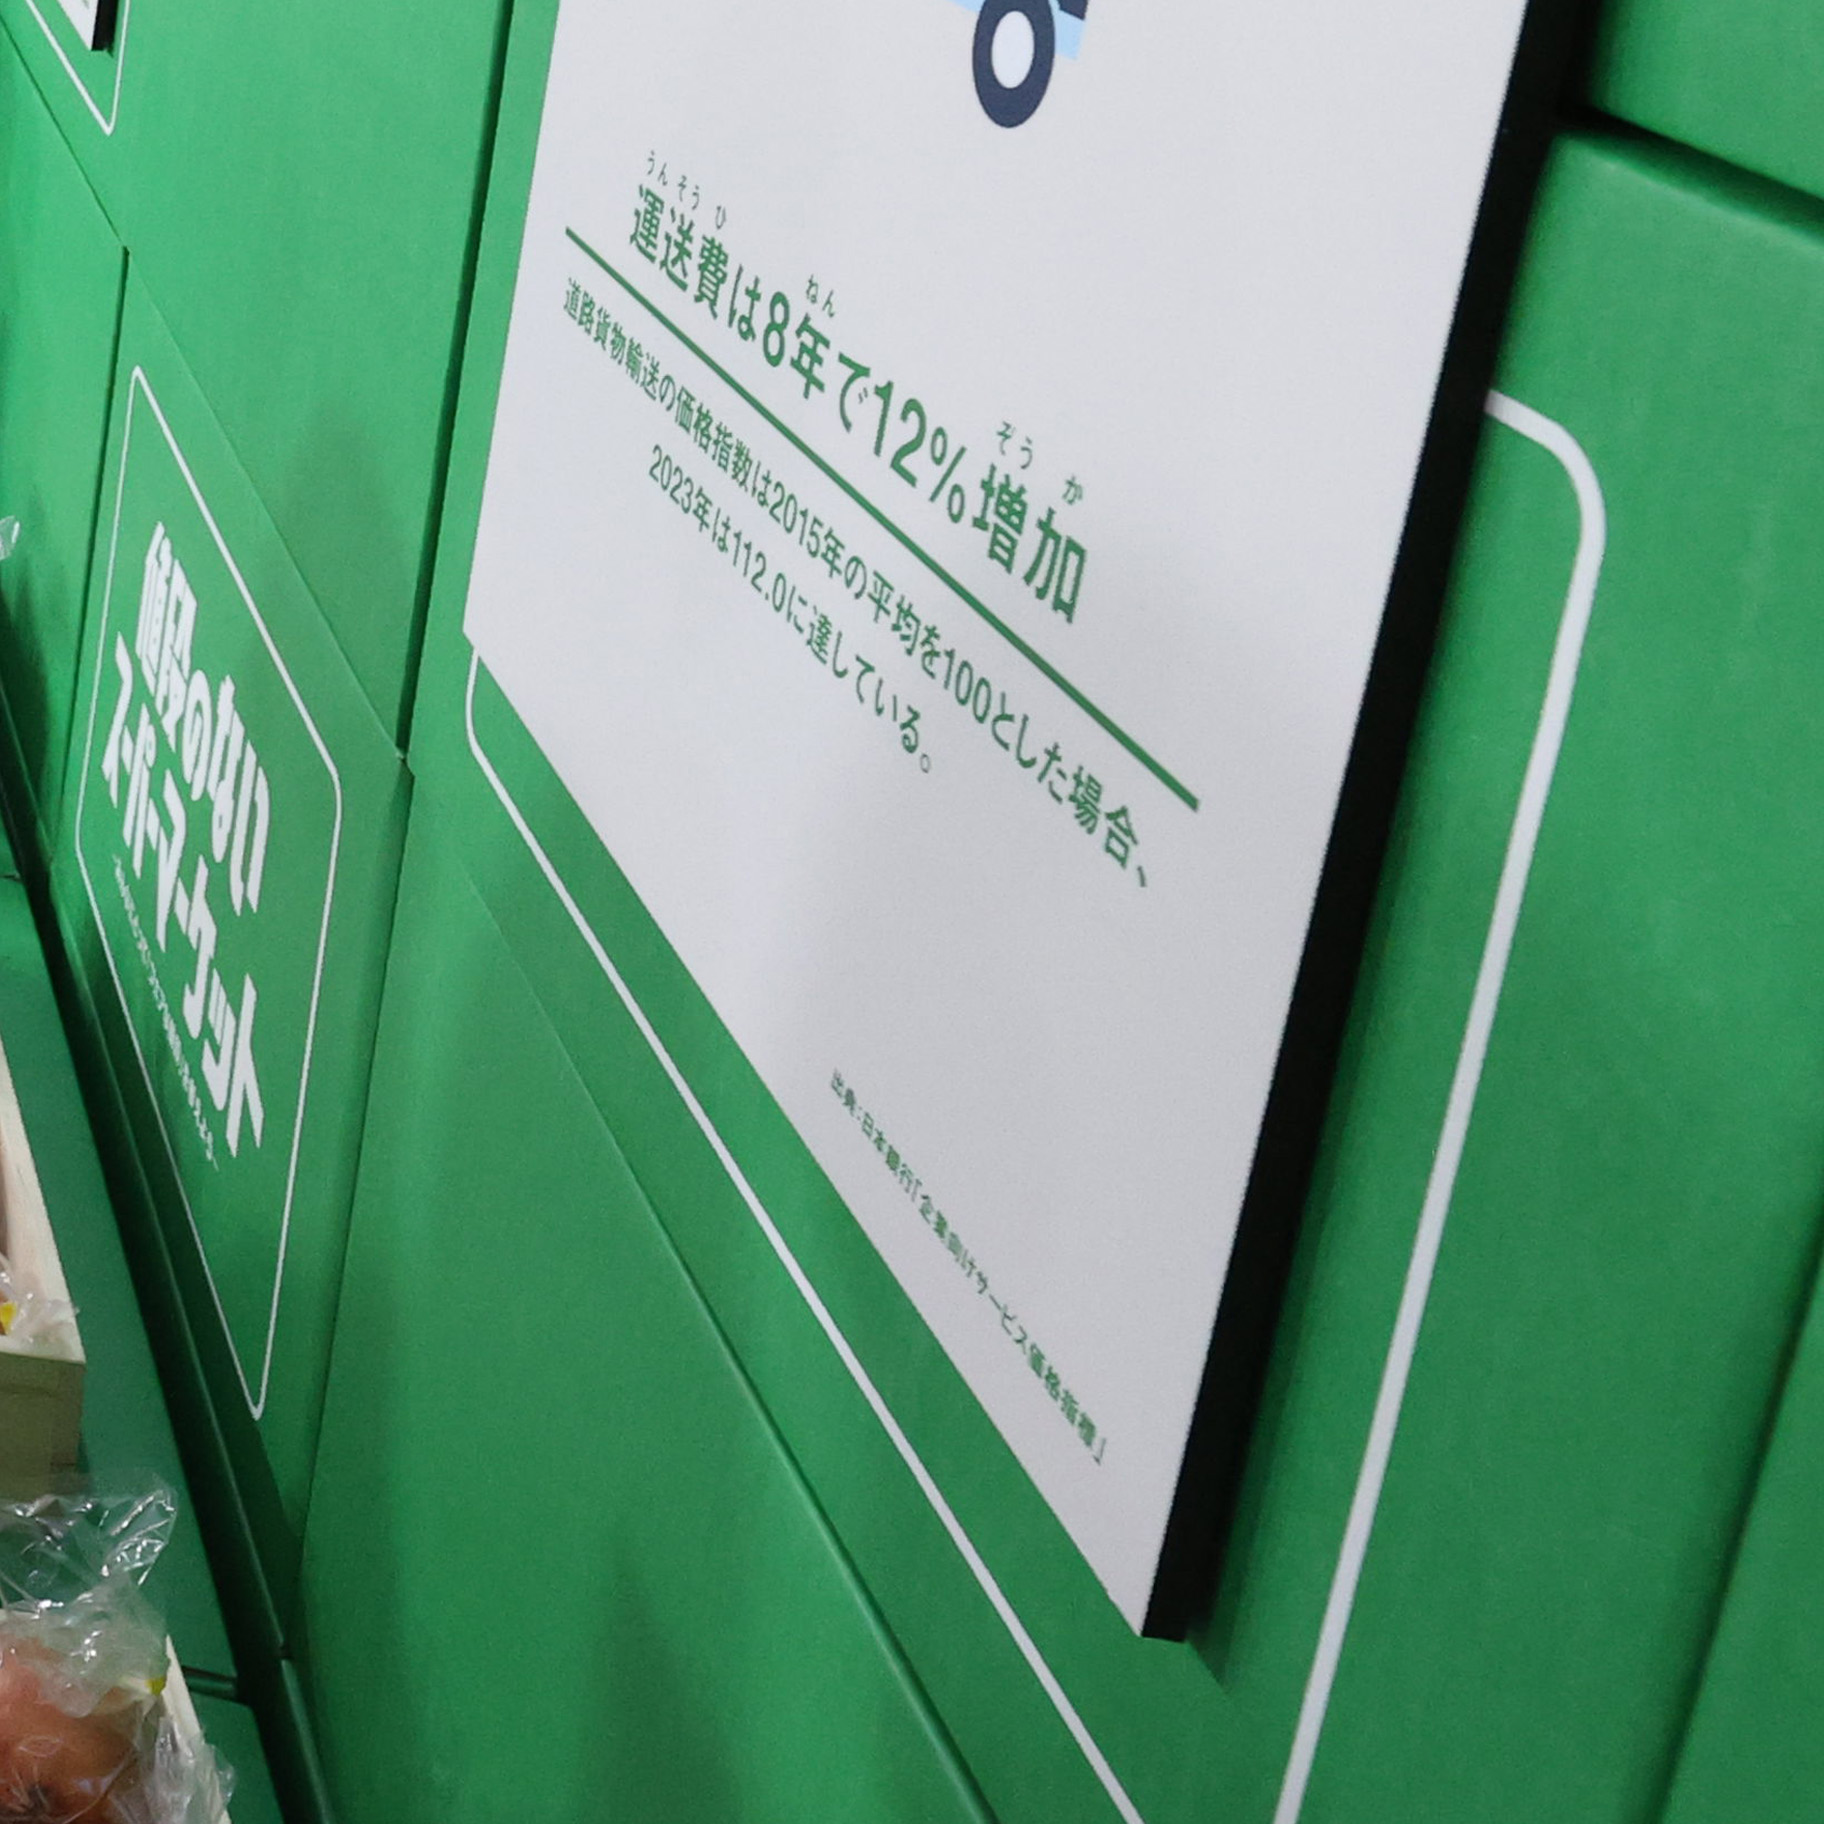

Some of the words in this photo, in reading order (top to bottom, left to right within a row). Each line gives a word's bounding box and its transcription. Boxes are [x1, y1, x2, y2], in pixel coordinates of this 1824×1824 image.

[628, 183, 1088, 625] 運送費は8年で12%増加
[648, 444, 932, 774] 2023年は112.0に達している。
[101, 632, 265, 1158] スーパーマーケット
[135, 521, 270, 917] 値段のない
